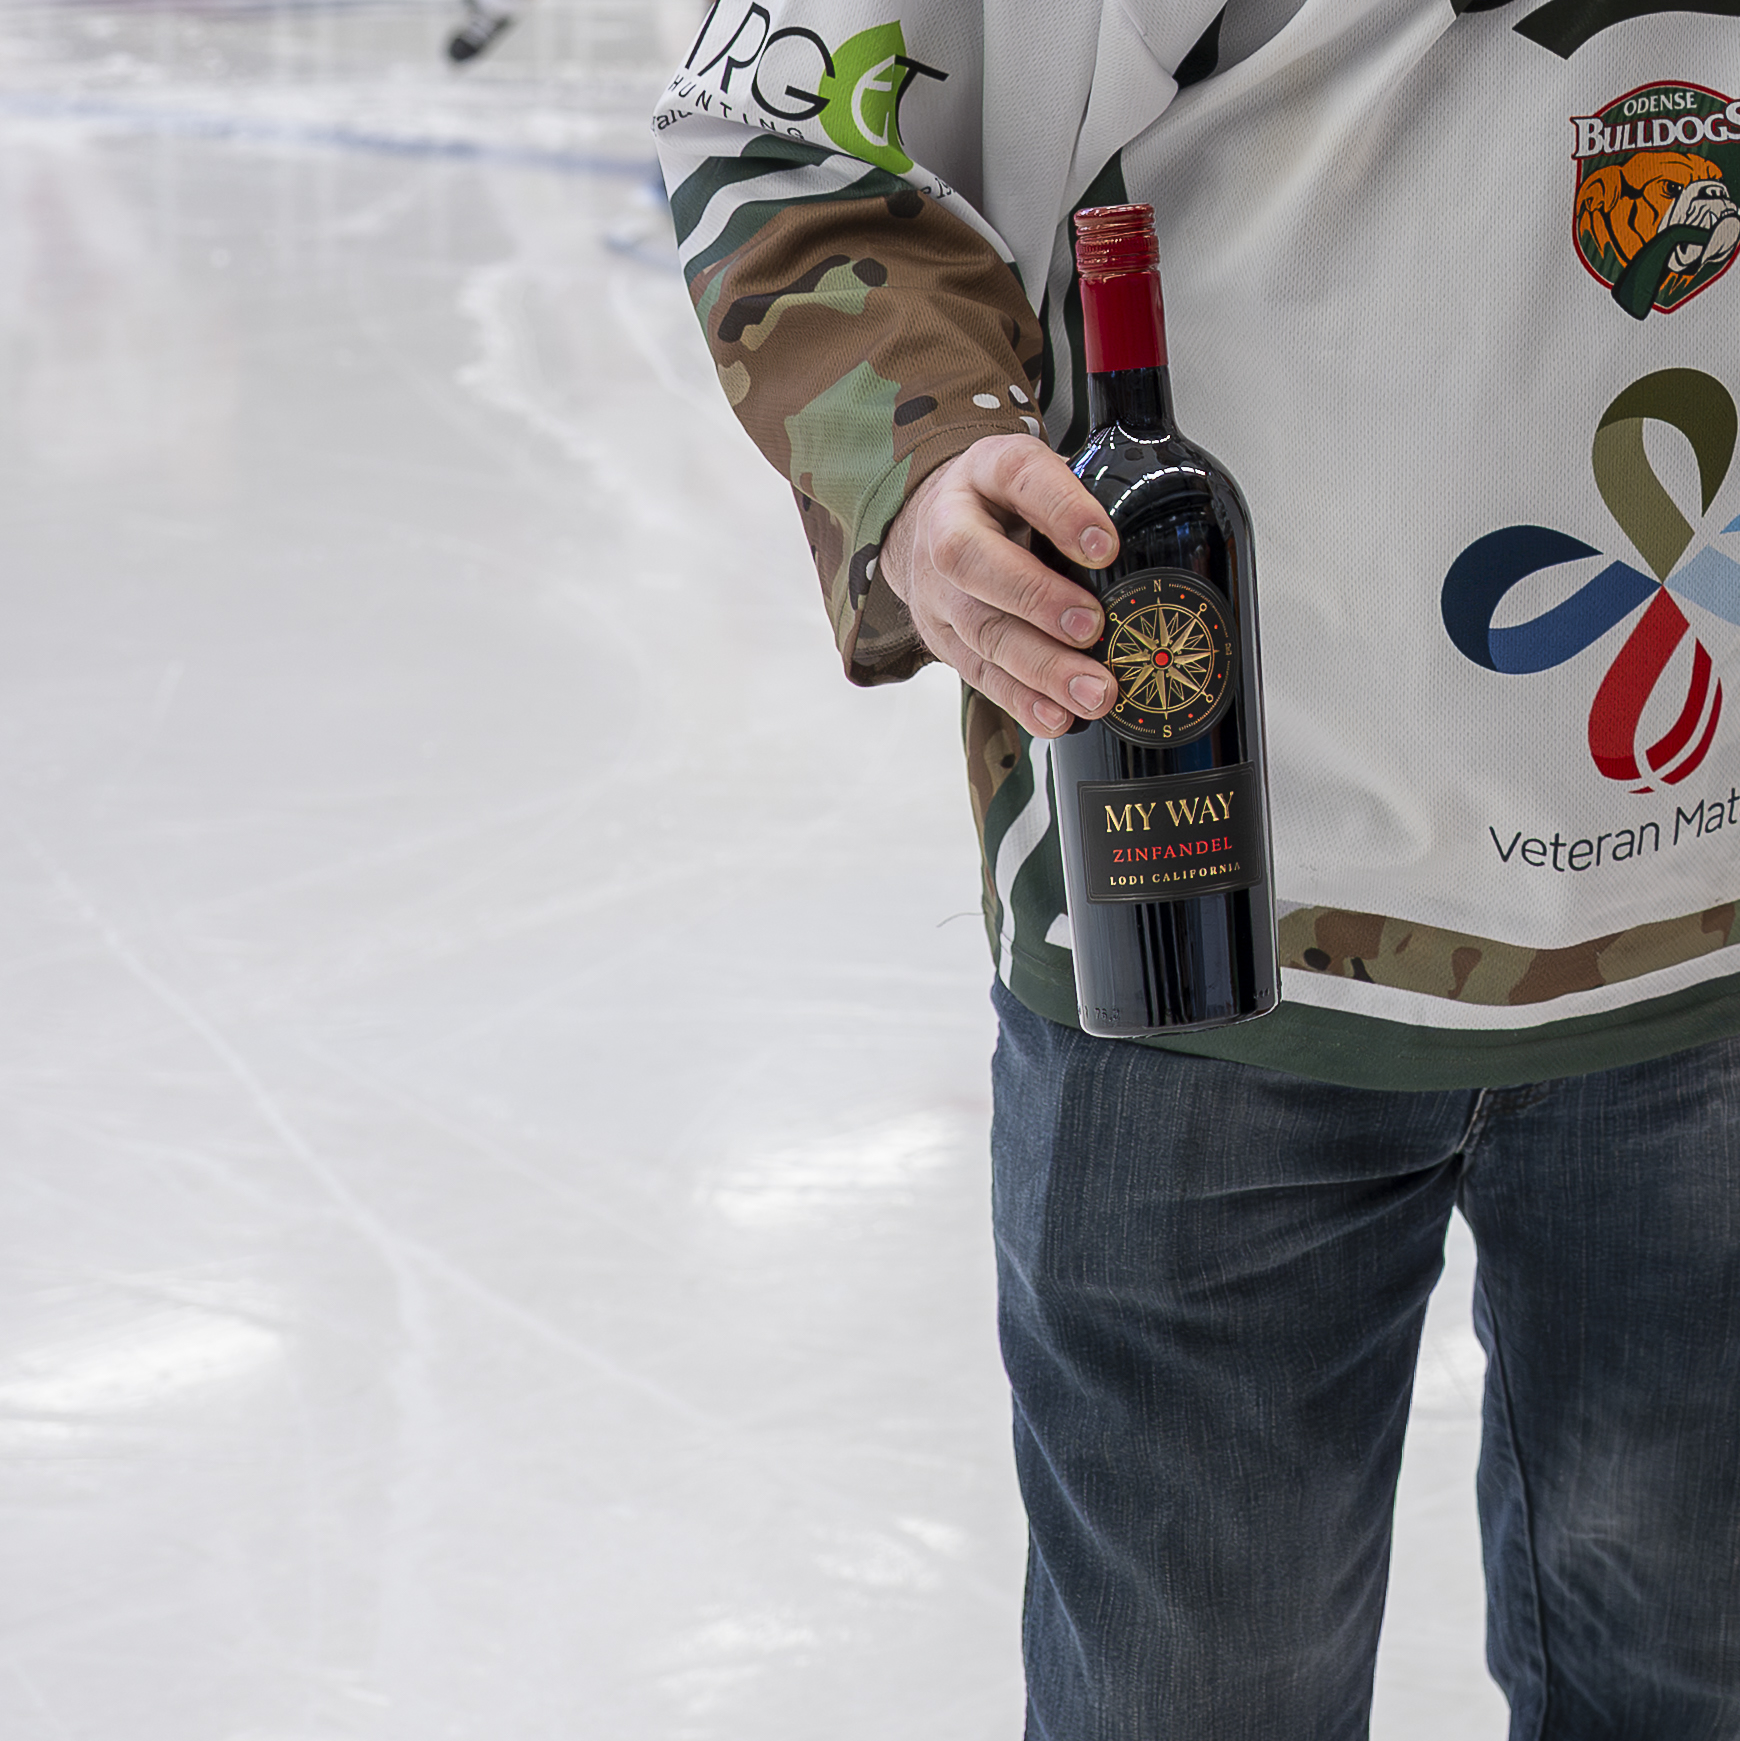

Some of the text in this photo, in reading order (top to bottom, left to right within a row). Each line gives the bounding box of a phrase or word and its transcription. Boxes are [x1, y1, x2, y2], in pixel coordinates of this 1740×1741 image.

[1623, 91, 1698, 117] ODENSE
[1104, 790, 1235, 833] MY WAY
[1112, 836, 1233, 863] ZINFANDEL
[1488, 820, 1660, 872] Veteran
[1110, 861, 1241, 886] LODI CALIFORNIA
